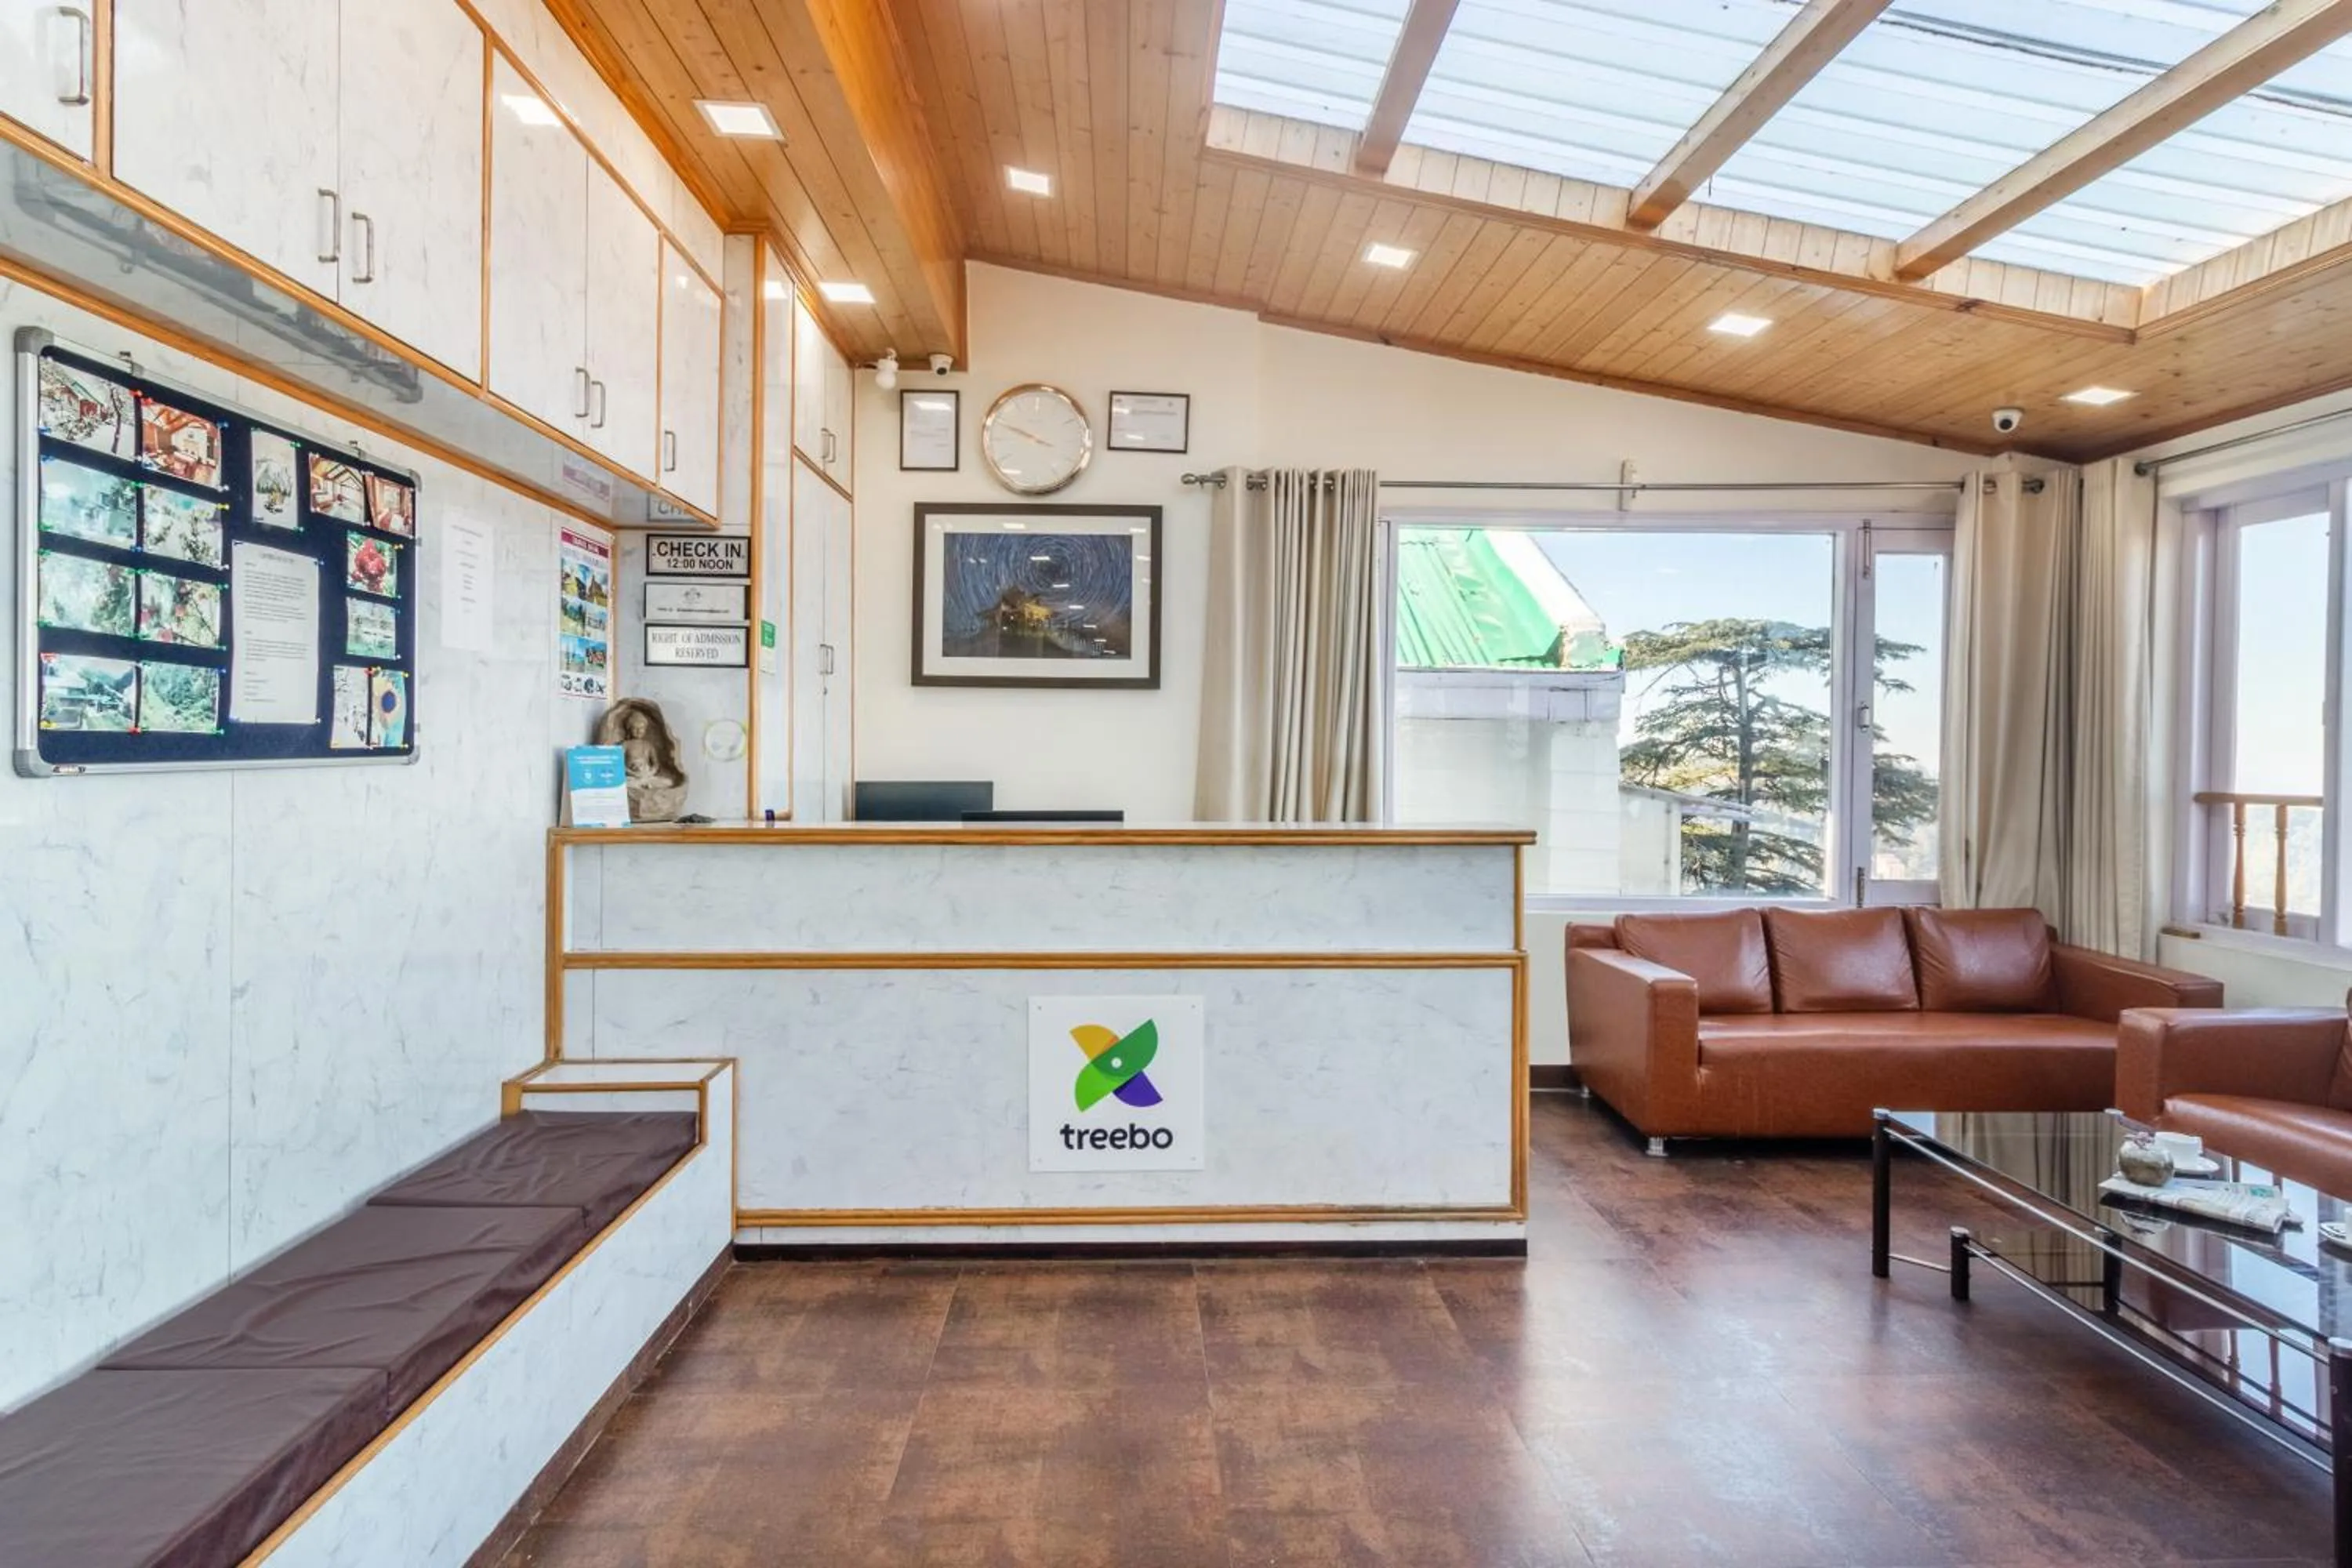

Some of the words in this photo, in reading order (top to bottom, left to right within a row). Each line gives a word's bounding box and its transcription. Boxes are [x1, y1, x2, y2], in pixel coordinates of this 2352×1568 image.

[656, 541, 719, 557] CHECK
[725, 543, 742, 558] IN
[666, 558, 695, 568] 12:00
[699, 559, 733, 570] NOON
[652, 633, 677, 643] RIGHT
[681, 633, 691, 643] OF
[694, 633, 741, 644] ADMISSION
[675, 647, 719, 659] RESERVED
[1059, 1123, 1174, 1150] treebo
